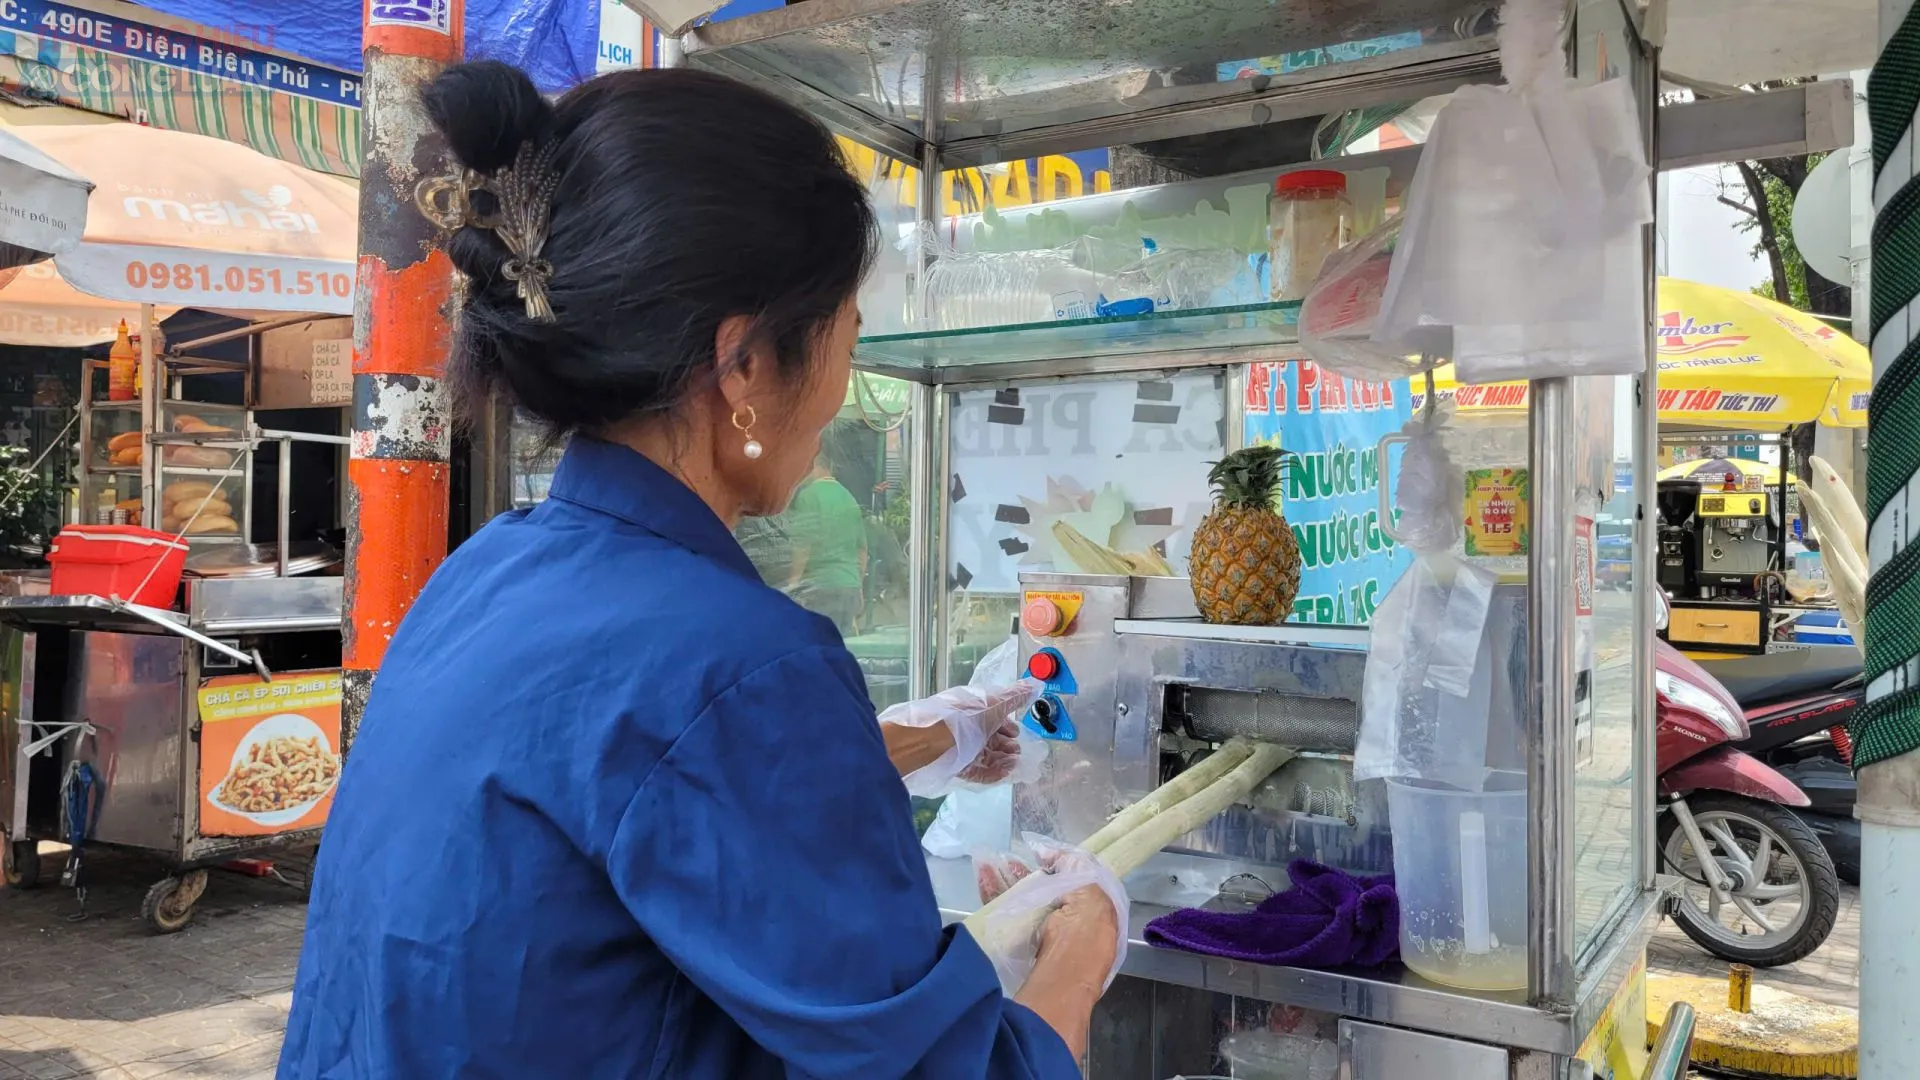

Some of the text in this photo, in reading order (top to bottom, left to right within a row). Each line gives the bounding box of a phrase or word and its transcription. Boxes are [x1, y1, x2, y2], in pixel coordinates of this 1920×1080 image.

[41, 9, 113, 44] 490E
[125, 27, 187, 60] Điện
[199, 44, 255, 77] Biên
[266, 61, 309, 89] Phủ
[599, 40, 632, 65] LỊCH
[126, 260, 350, 298] 0981.051.510
[1657, 317, 1734, 337] mber
[1678, 386, 1722, 411] TÁO
[1289, 442, 1357, 499] NƯỚC
[1292, 507, 1360, 568] NƯỚC
[1673, 725, 1707, 743] HONDA
